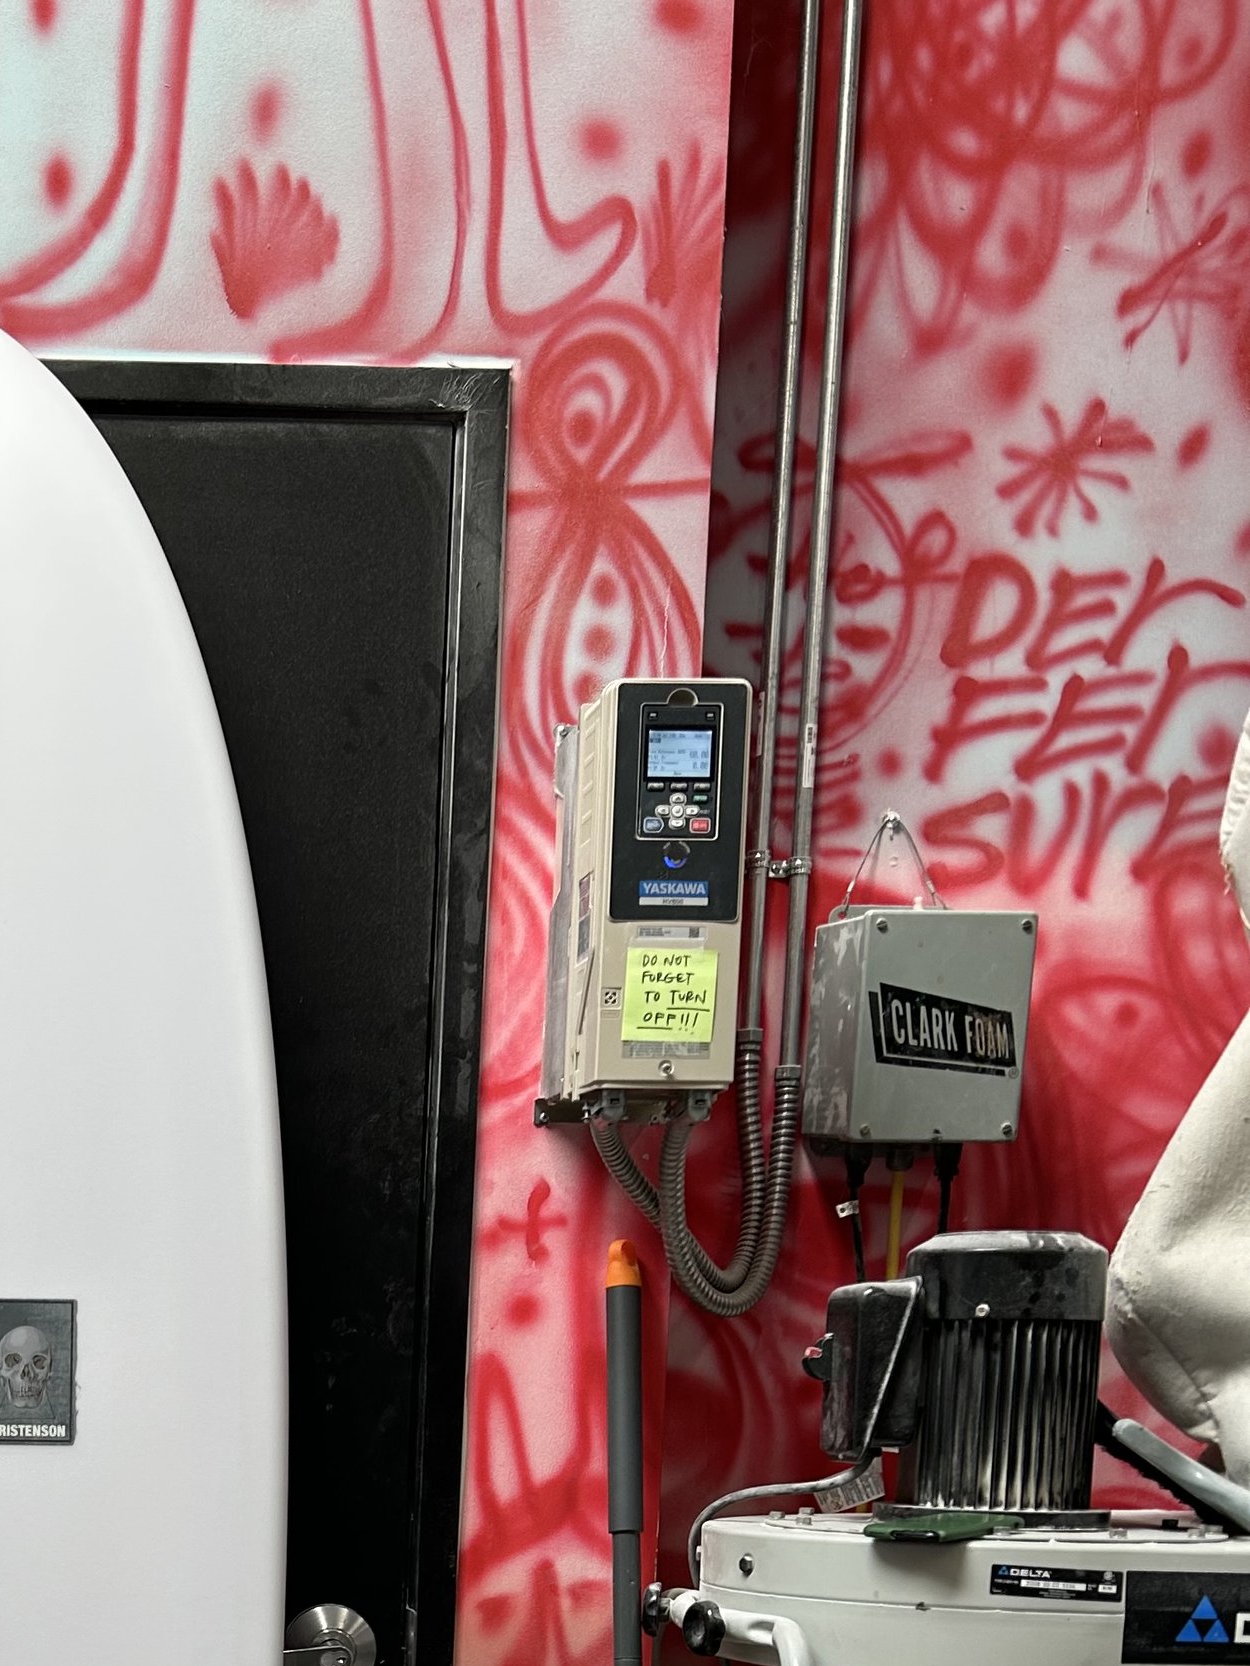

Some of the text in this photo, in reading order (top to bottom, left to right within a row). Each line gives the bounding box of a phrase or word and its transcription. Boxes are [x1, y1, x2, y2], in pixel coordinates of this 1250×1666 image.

[643, 882, 706, 895] YASKAWA
[642, 954, 691, 967] DO NOT
[641, 971, 694, 985] FORGET
[644, 989, 707, 1005] TO TURN
[891, 998, 1010, 1060] CLARK FOAM
[1010, 1568, 1051, 1578] DELTA
